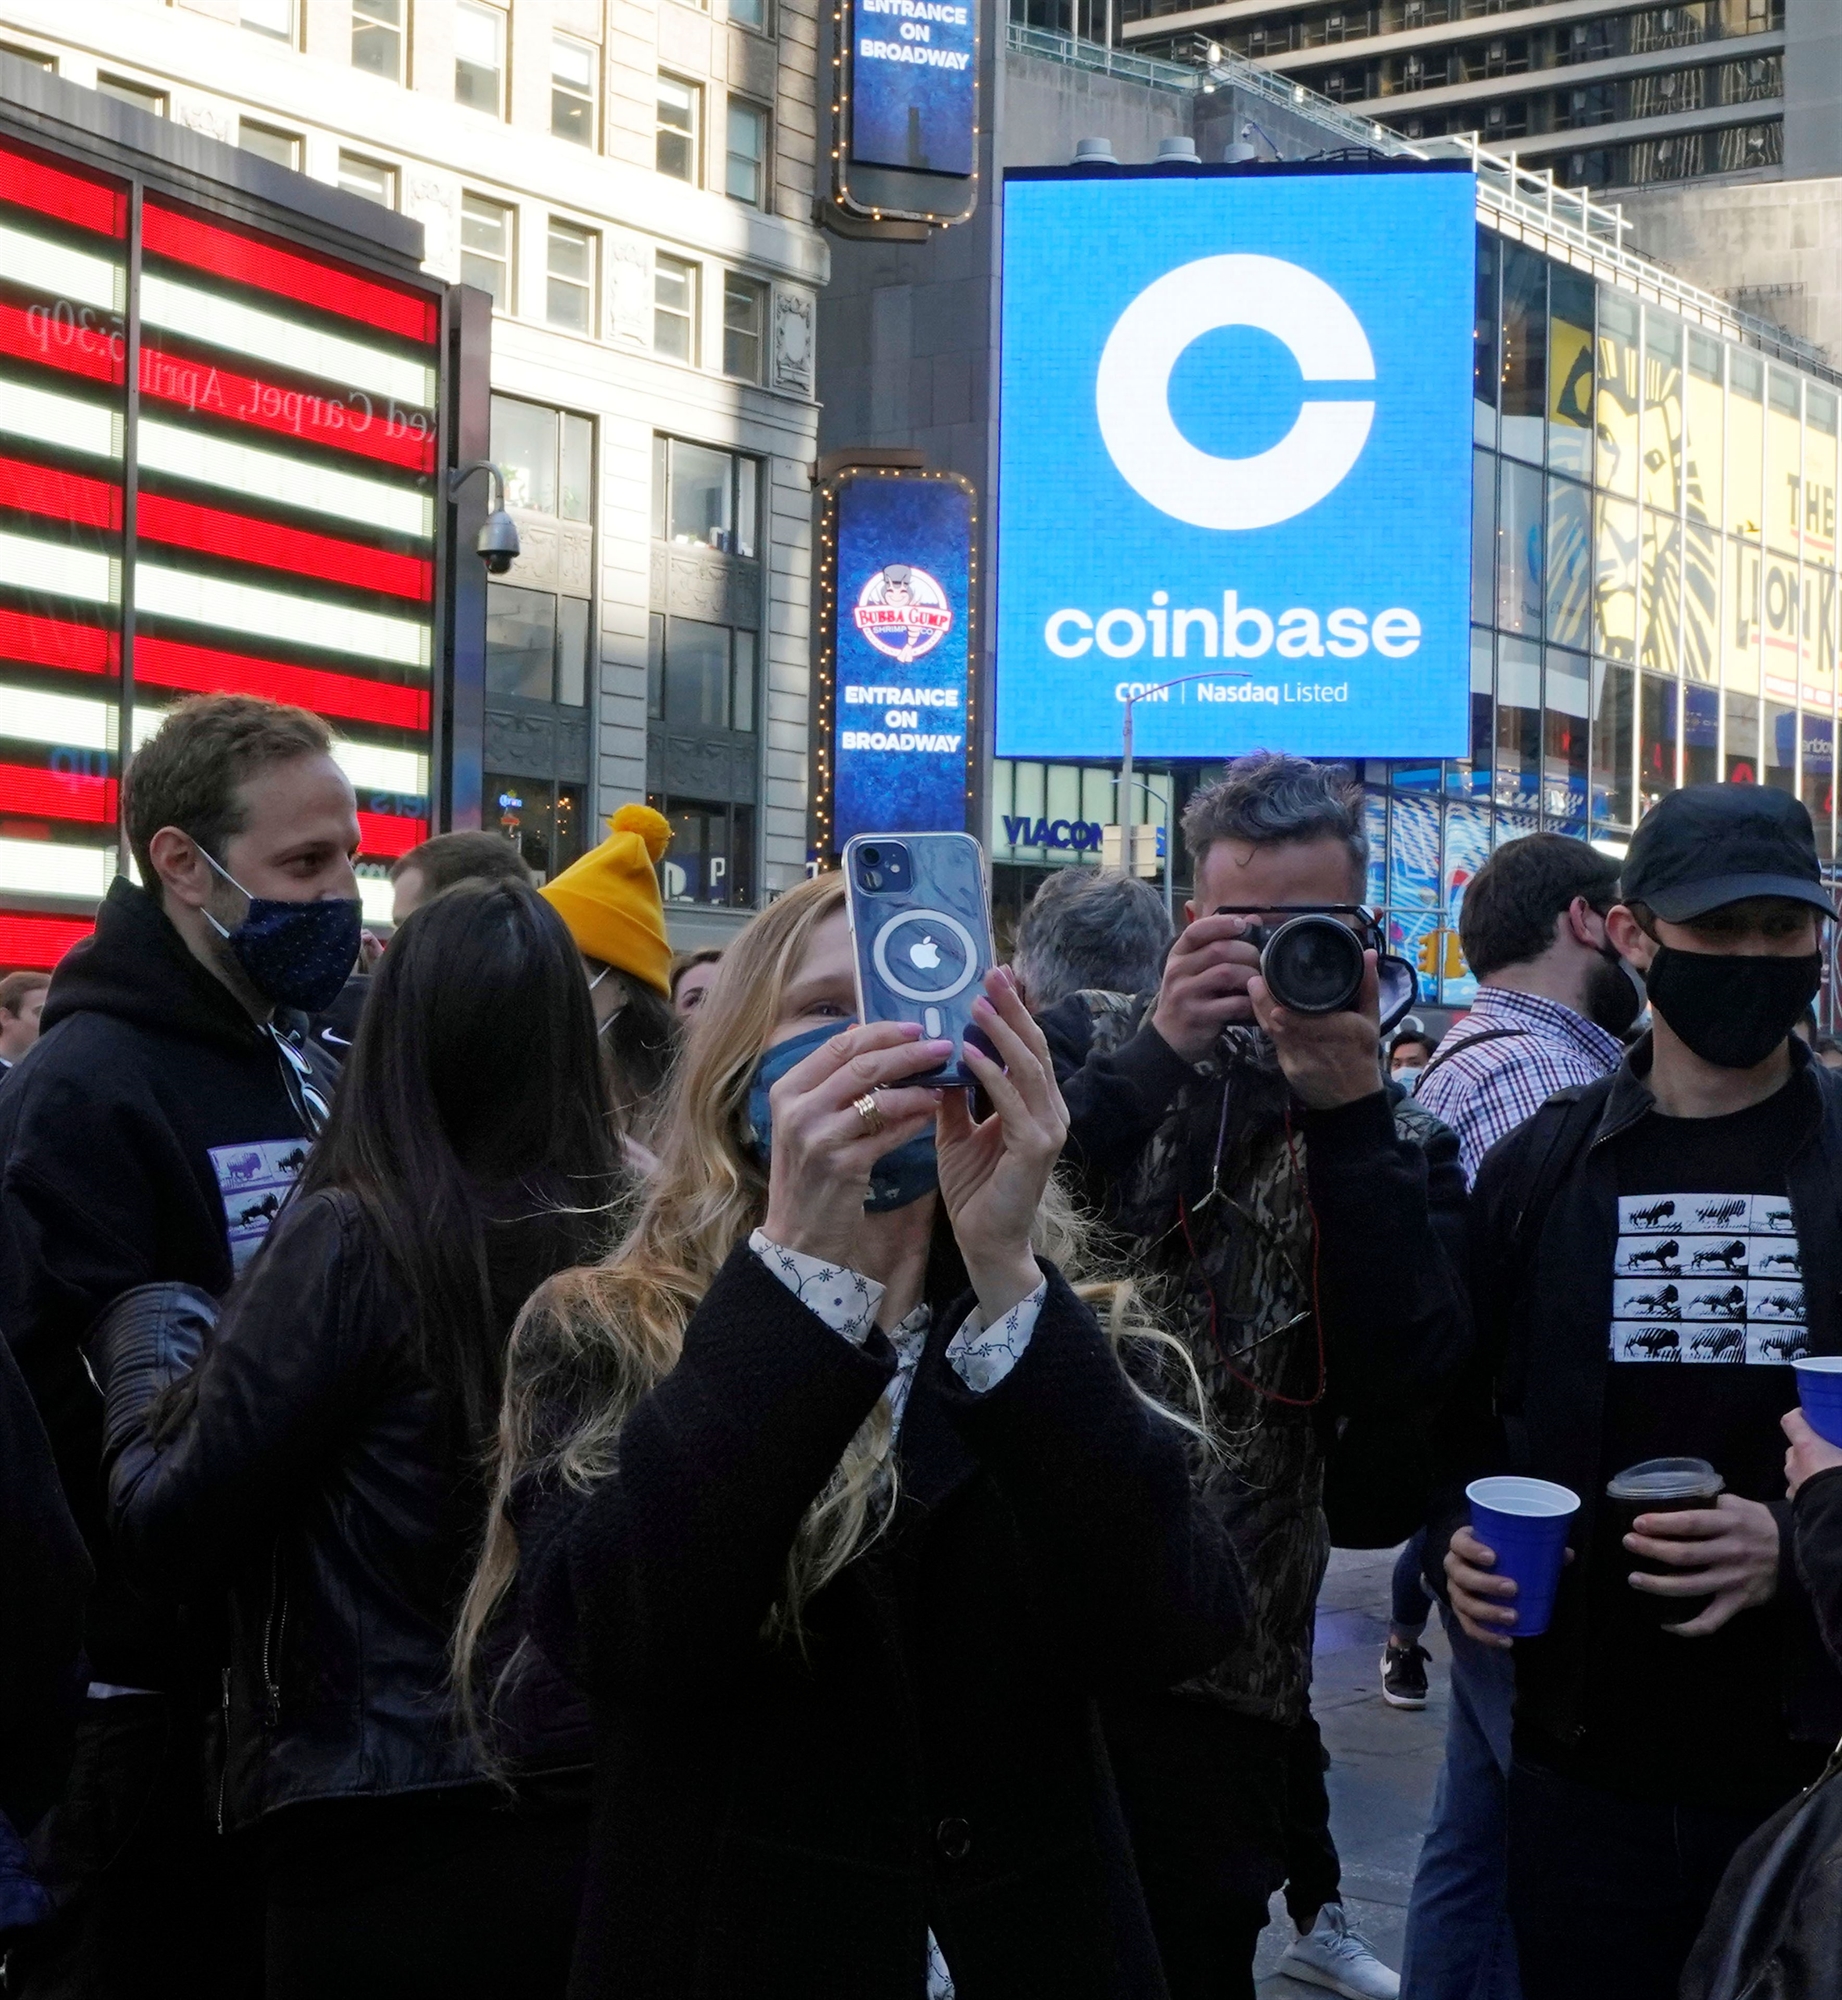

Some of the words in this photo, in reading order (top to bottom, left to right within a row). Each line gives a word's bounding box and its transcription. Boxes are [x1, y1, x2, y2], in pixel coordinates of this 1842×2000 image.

[863, 0, 967, 24] ENTRANCE
[900, 22, 931, 43] ON
[860, 39, 970, 71] BROADWAY
[1787, 473, 1834, 538] THE
[858, 609, 905, 626] BUBBA
[908, 608, 949, 628] GUMP
[1043, 590, 1422, 658] coinbase
[872, 625, 907, 634] SHRIMP
[844, 686, 959, 708] ENTRANCE
[1115, 682, 1169, 703] COIN
[1197, 682, 1279, 705] Nasdaq
[1284, 682, 1348, 703] Listed
[885, 710, 918, 729] ON
[842, 731, 962, 753] BROADWAY
